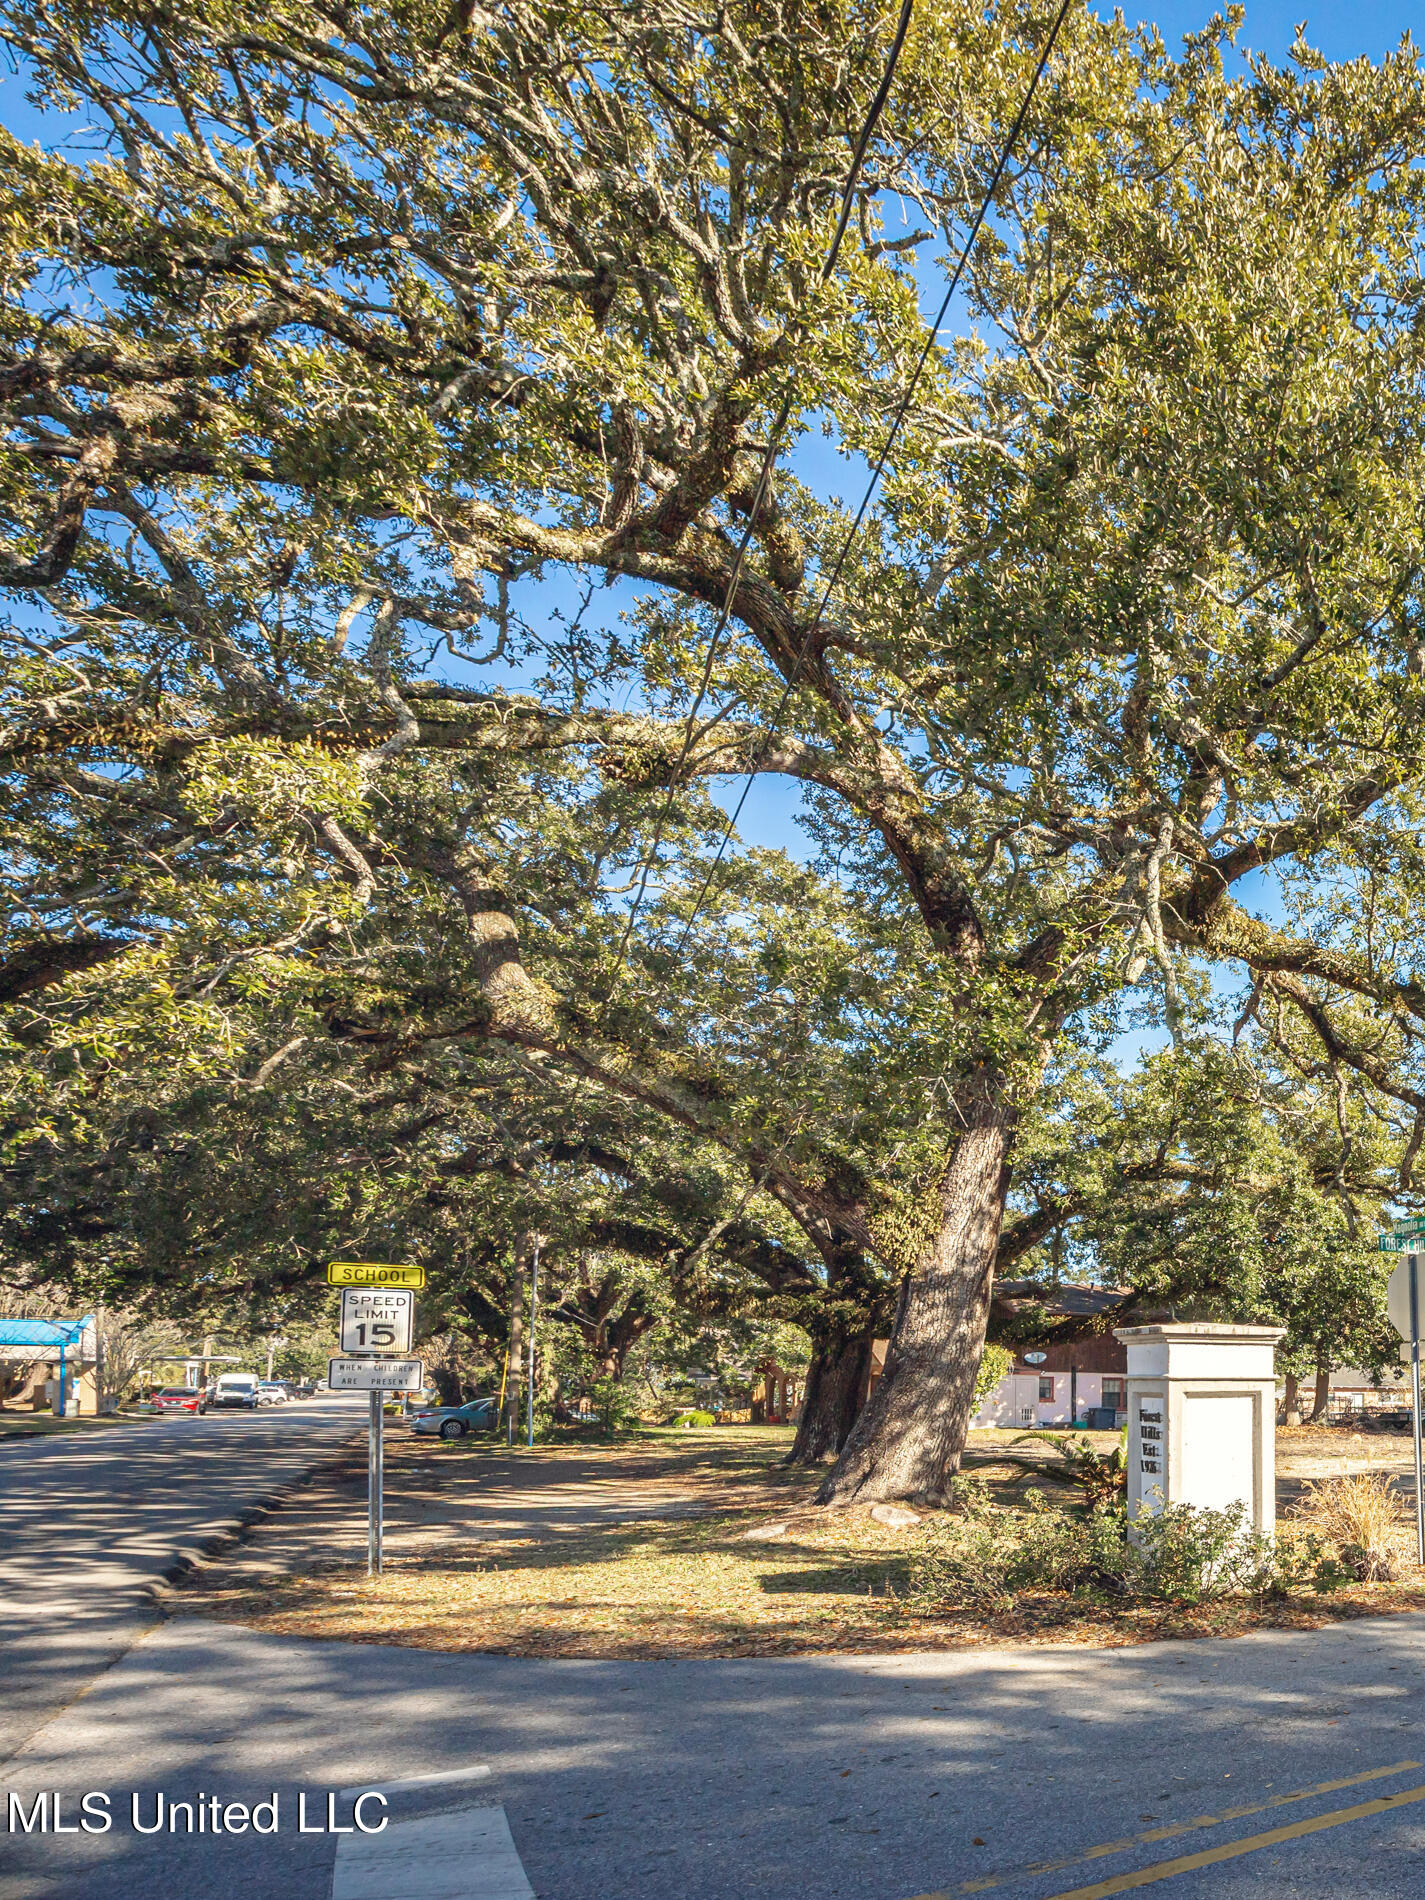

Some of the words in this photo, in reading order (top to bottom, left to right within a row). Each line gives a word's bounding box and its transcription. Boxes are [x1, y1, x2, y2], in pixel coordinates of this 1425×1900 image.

[1393, 1220, 1418, 1236] Magnolia
[342, 1268, 411, 1283] SCHOOL
[348, 1295, 407, 1307] SPEED
[354, 1310, 399, 1320] LIMIT
[355, 1323, 396, 1347] 15
[373, 1364, 413, 1372] CHILDREN
[341, 1377, 358, 1385] ARE
[371, 1378, 409, 1386] PRESENT
[1139, 1408, 1162, 1423] Forest
[1140, 1425, 1162, 1440] Hills
